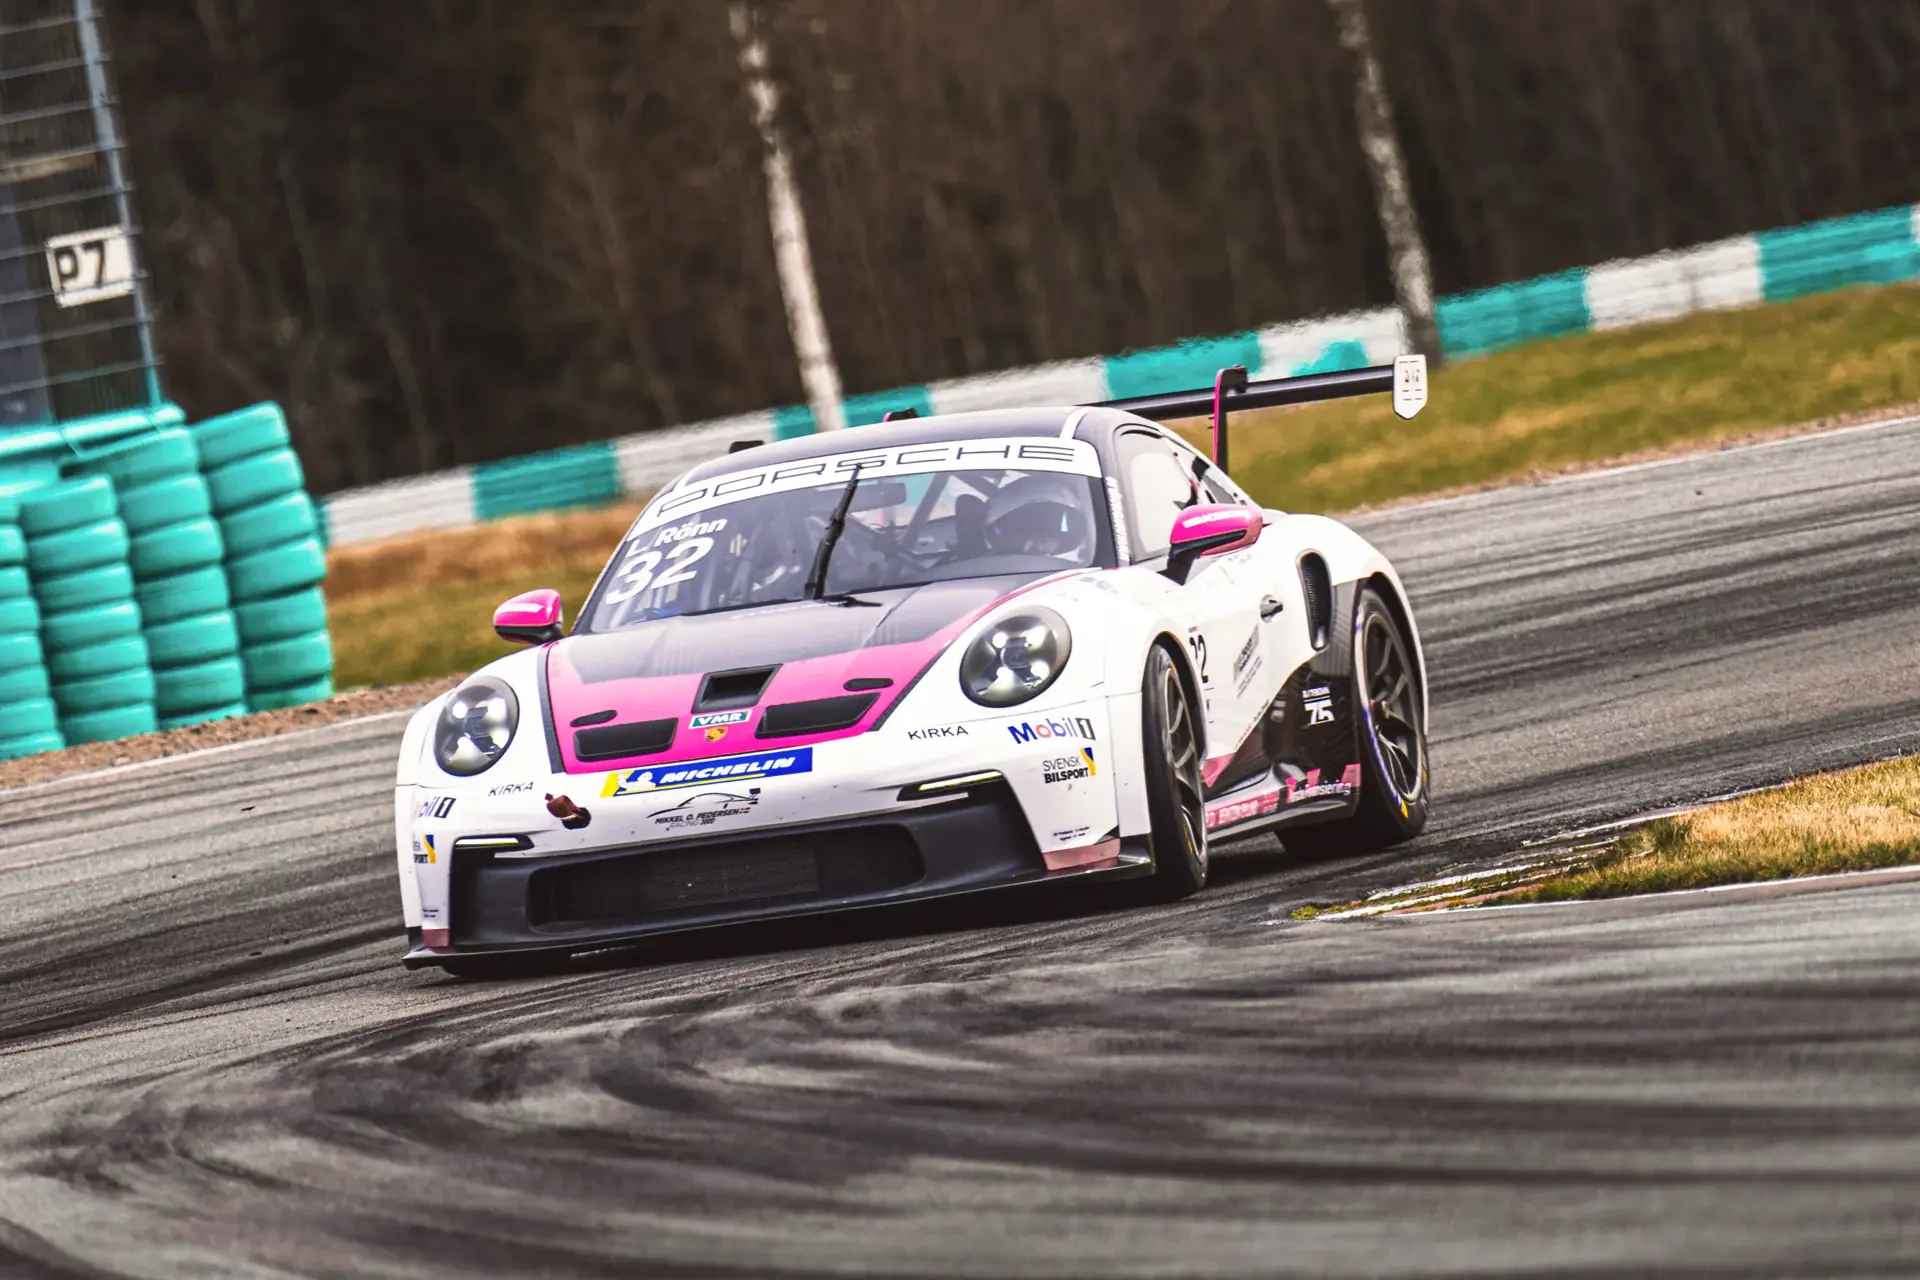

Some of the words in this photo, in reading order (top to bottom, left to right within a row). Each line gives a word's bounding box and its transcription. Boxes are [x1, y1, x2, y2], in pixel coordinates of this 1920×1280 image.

[53, 240, 105, 290] P7
[656, 445, 1075, 517] PORSCHE
[653, 519, 728, 547] Rönn
[605, 537, 714, 604] 32
[698, 713, 744, 726] VMR
[1304, 699, 1335, 725] 75
[907, 725, 969, 741] KIRKA
[1007, 717, 1076, 744] Mobil
[659, 757, 796, 784] MICHELIN
[1043, 756, 1081, 771] SVENSK
[1044, 767, 1089, 784] BILSPORT
[488, 781, 534, 797] KIRKA
[696, 808, 740, 820] PEDERSEN
